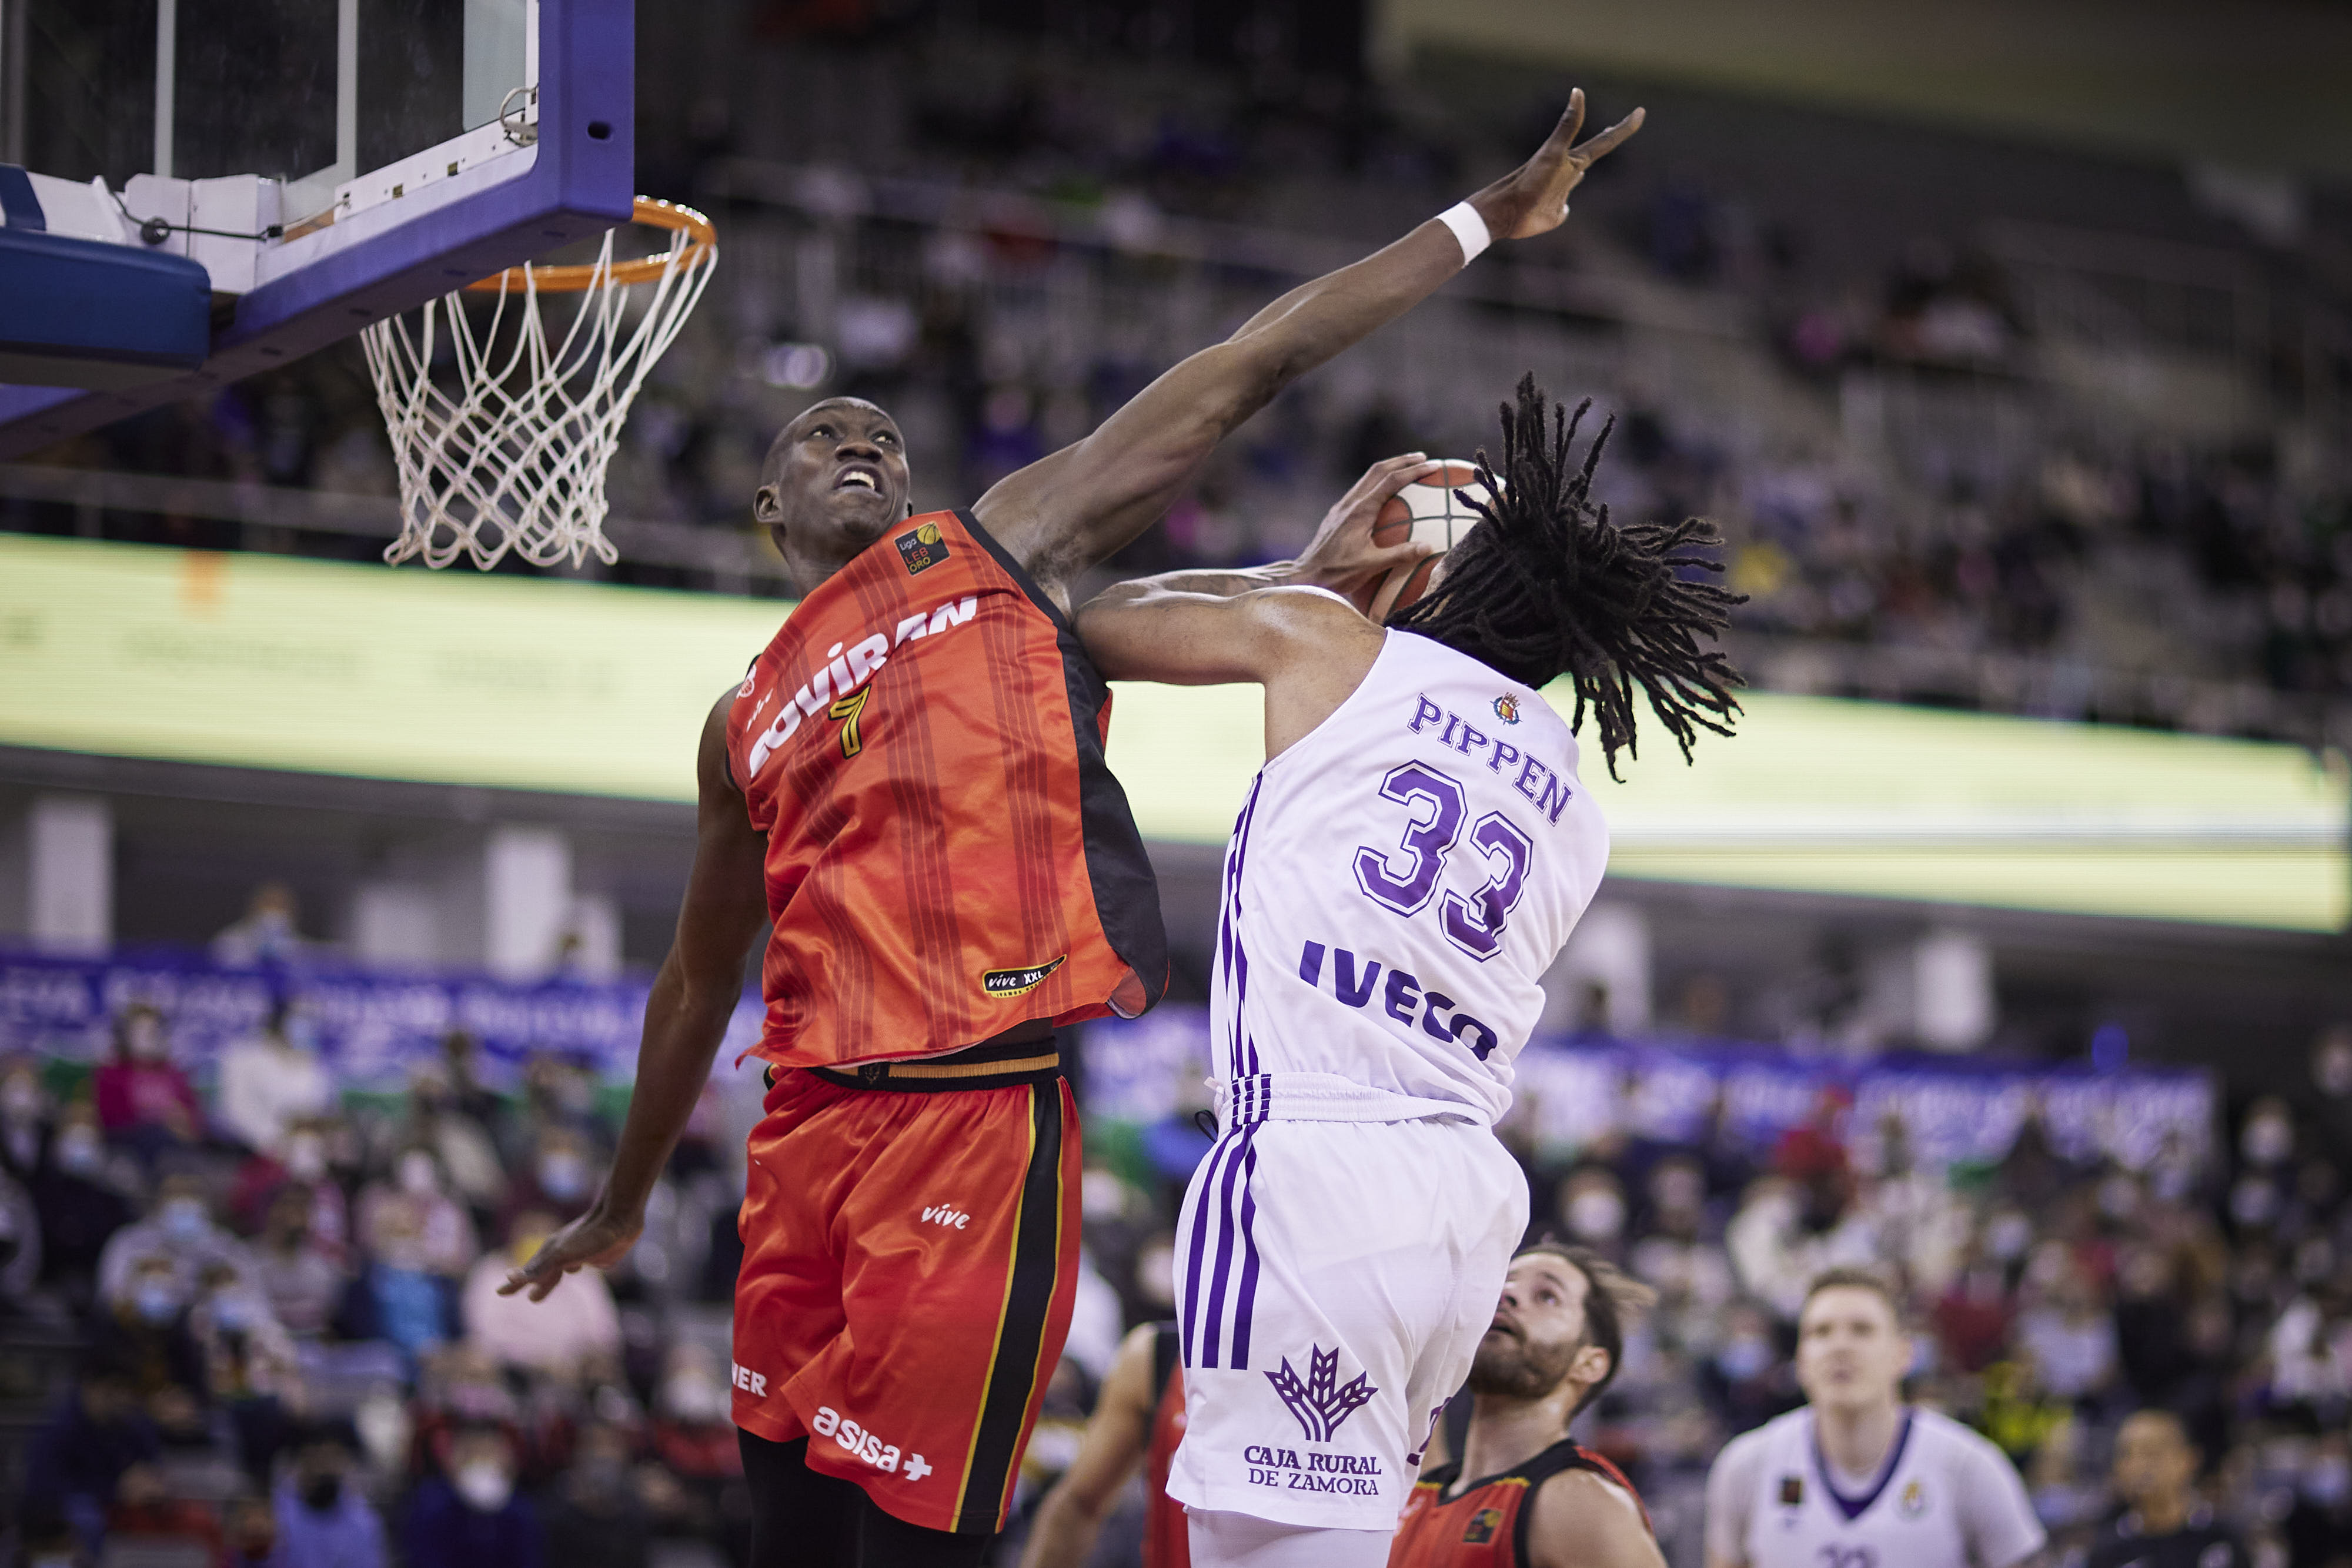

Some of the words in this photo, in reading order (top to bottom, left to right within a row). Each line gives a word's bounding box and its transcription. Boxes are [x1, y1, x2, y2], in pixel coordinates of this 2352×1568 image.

[906, 547, 929, 564] LEB
[909, 556, 931, 573] ORO
[828, 683, 872, 760] 7
[1407, 693, 1572, 827] PIPPEN
[1352, 759, 1533, 963] 33
[1024, 971, 1044, 985] XXL
[1299, 940, 1498, 1061] IVECO
[921, 1203, 970, 1229] vive
[1244, 1445, 1299, 1469] CAJA
[1308, 1452, 1381, 1475] RURAL
[1249, 1468, 1279, 1486] DE
[1288, 1472, 1379, 1495] ZAMORA
